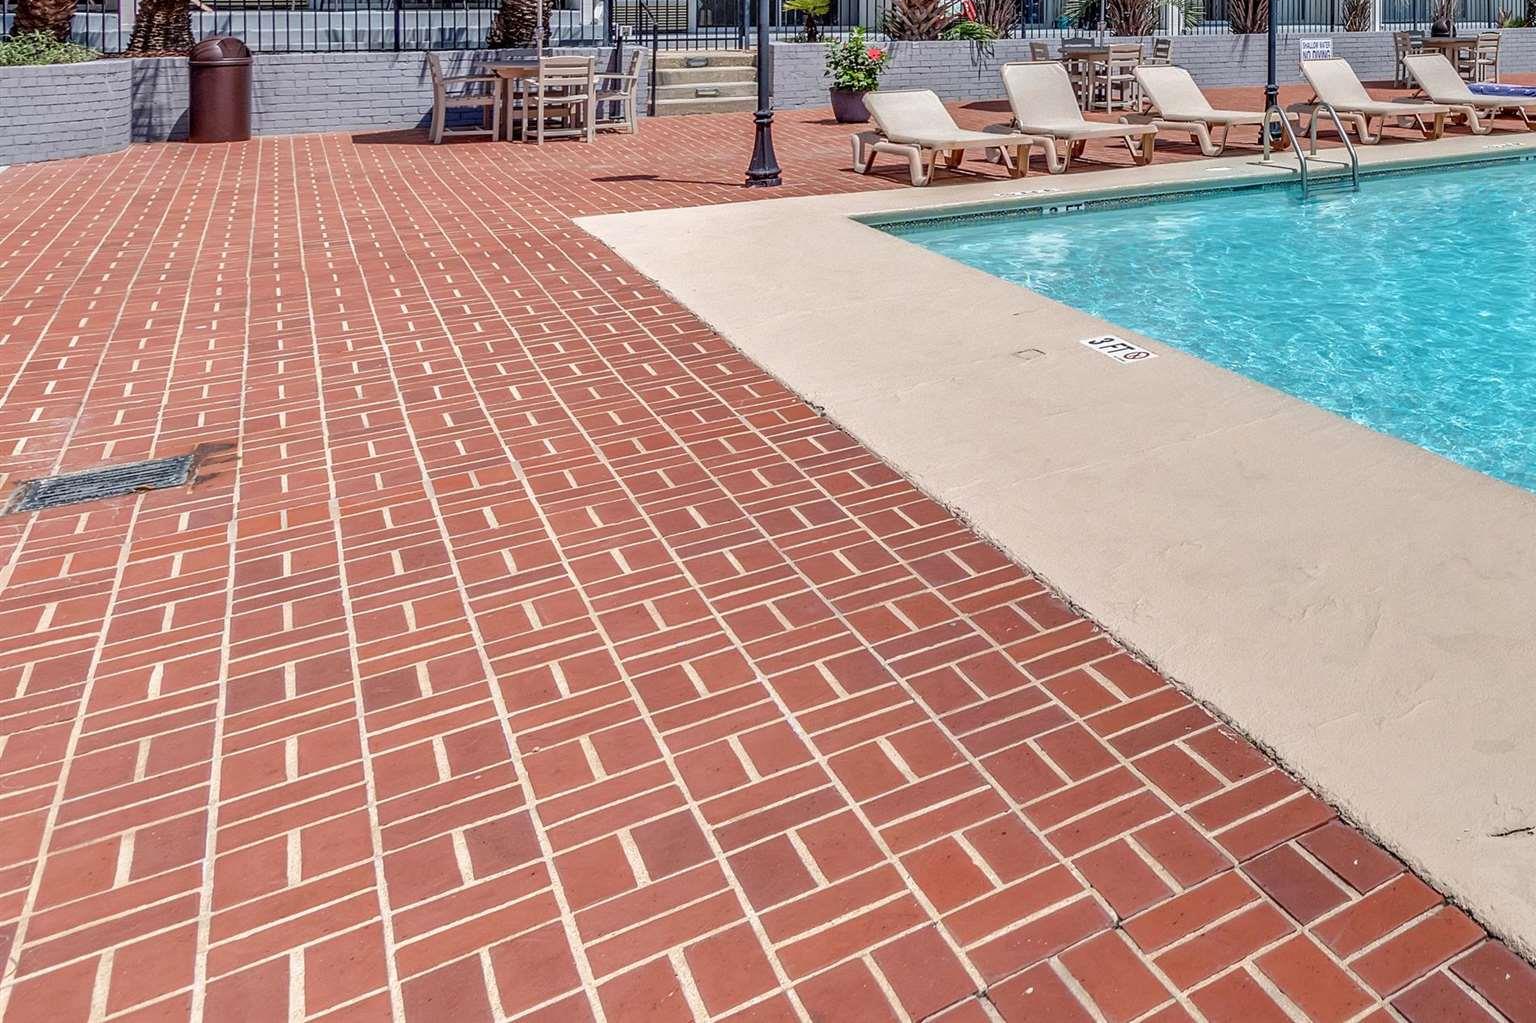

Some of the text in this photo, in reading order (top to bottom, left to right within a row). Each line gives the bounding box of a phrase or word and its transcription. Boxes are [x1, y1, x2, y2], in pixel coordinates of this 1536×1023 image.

[1302, 50, 1311, 59] NO
[1088, 337, 1136, 354] 3 FT
